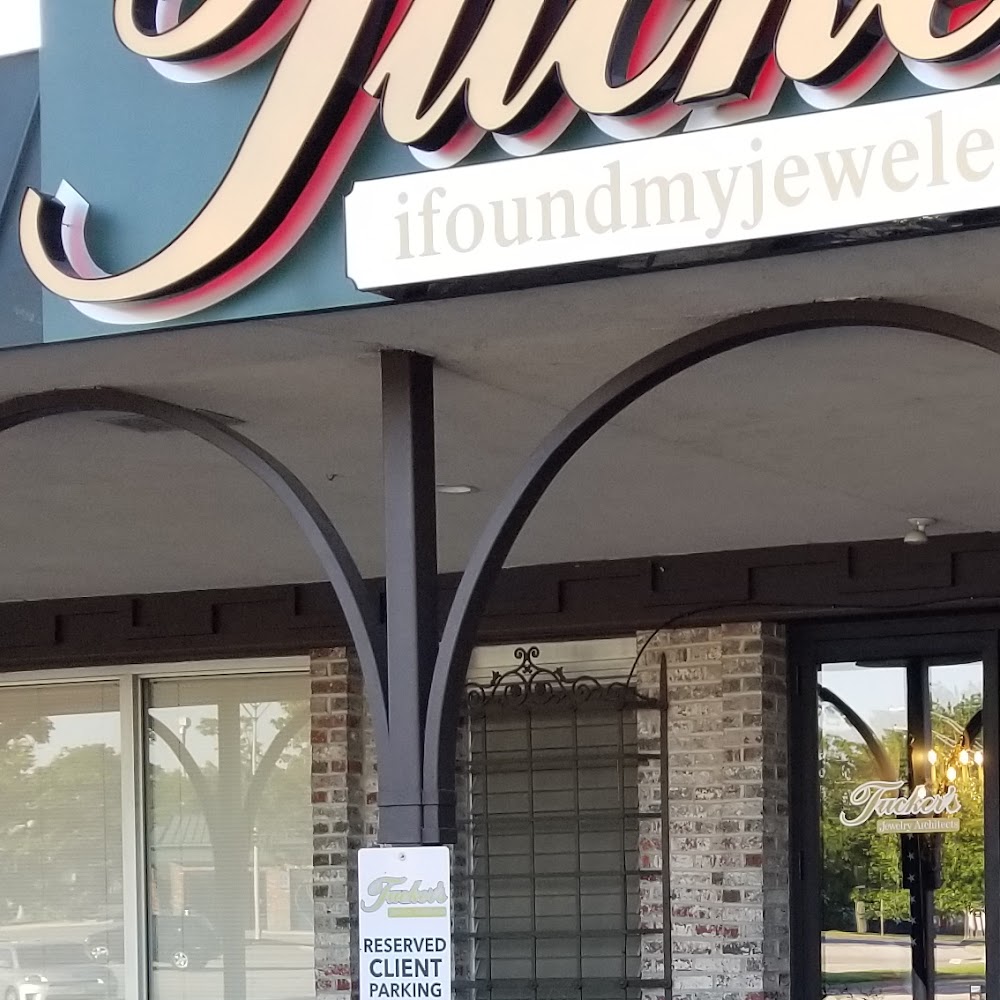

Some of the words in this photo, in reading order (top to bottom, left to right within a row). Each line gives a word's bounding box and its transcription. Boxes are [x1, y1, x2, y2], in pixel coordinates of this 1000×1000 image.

[880, 822, 911, 831] Jewelry
[914, 820, 958, 830] Architects
[364, 938, 446, 953] RESERVED
[369, 959, 442, 978] CLIENT
[369, 983, 442, 998] PARKING
